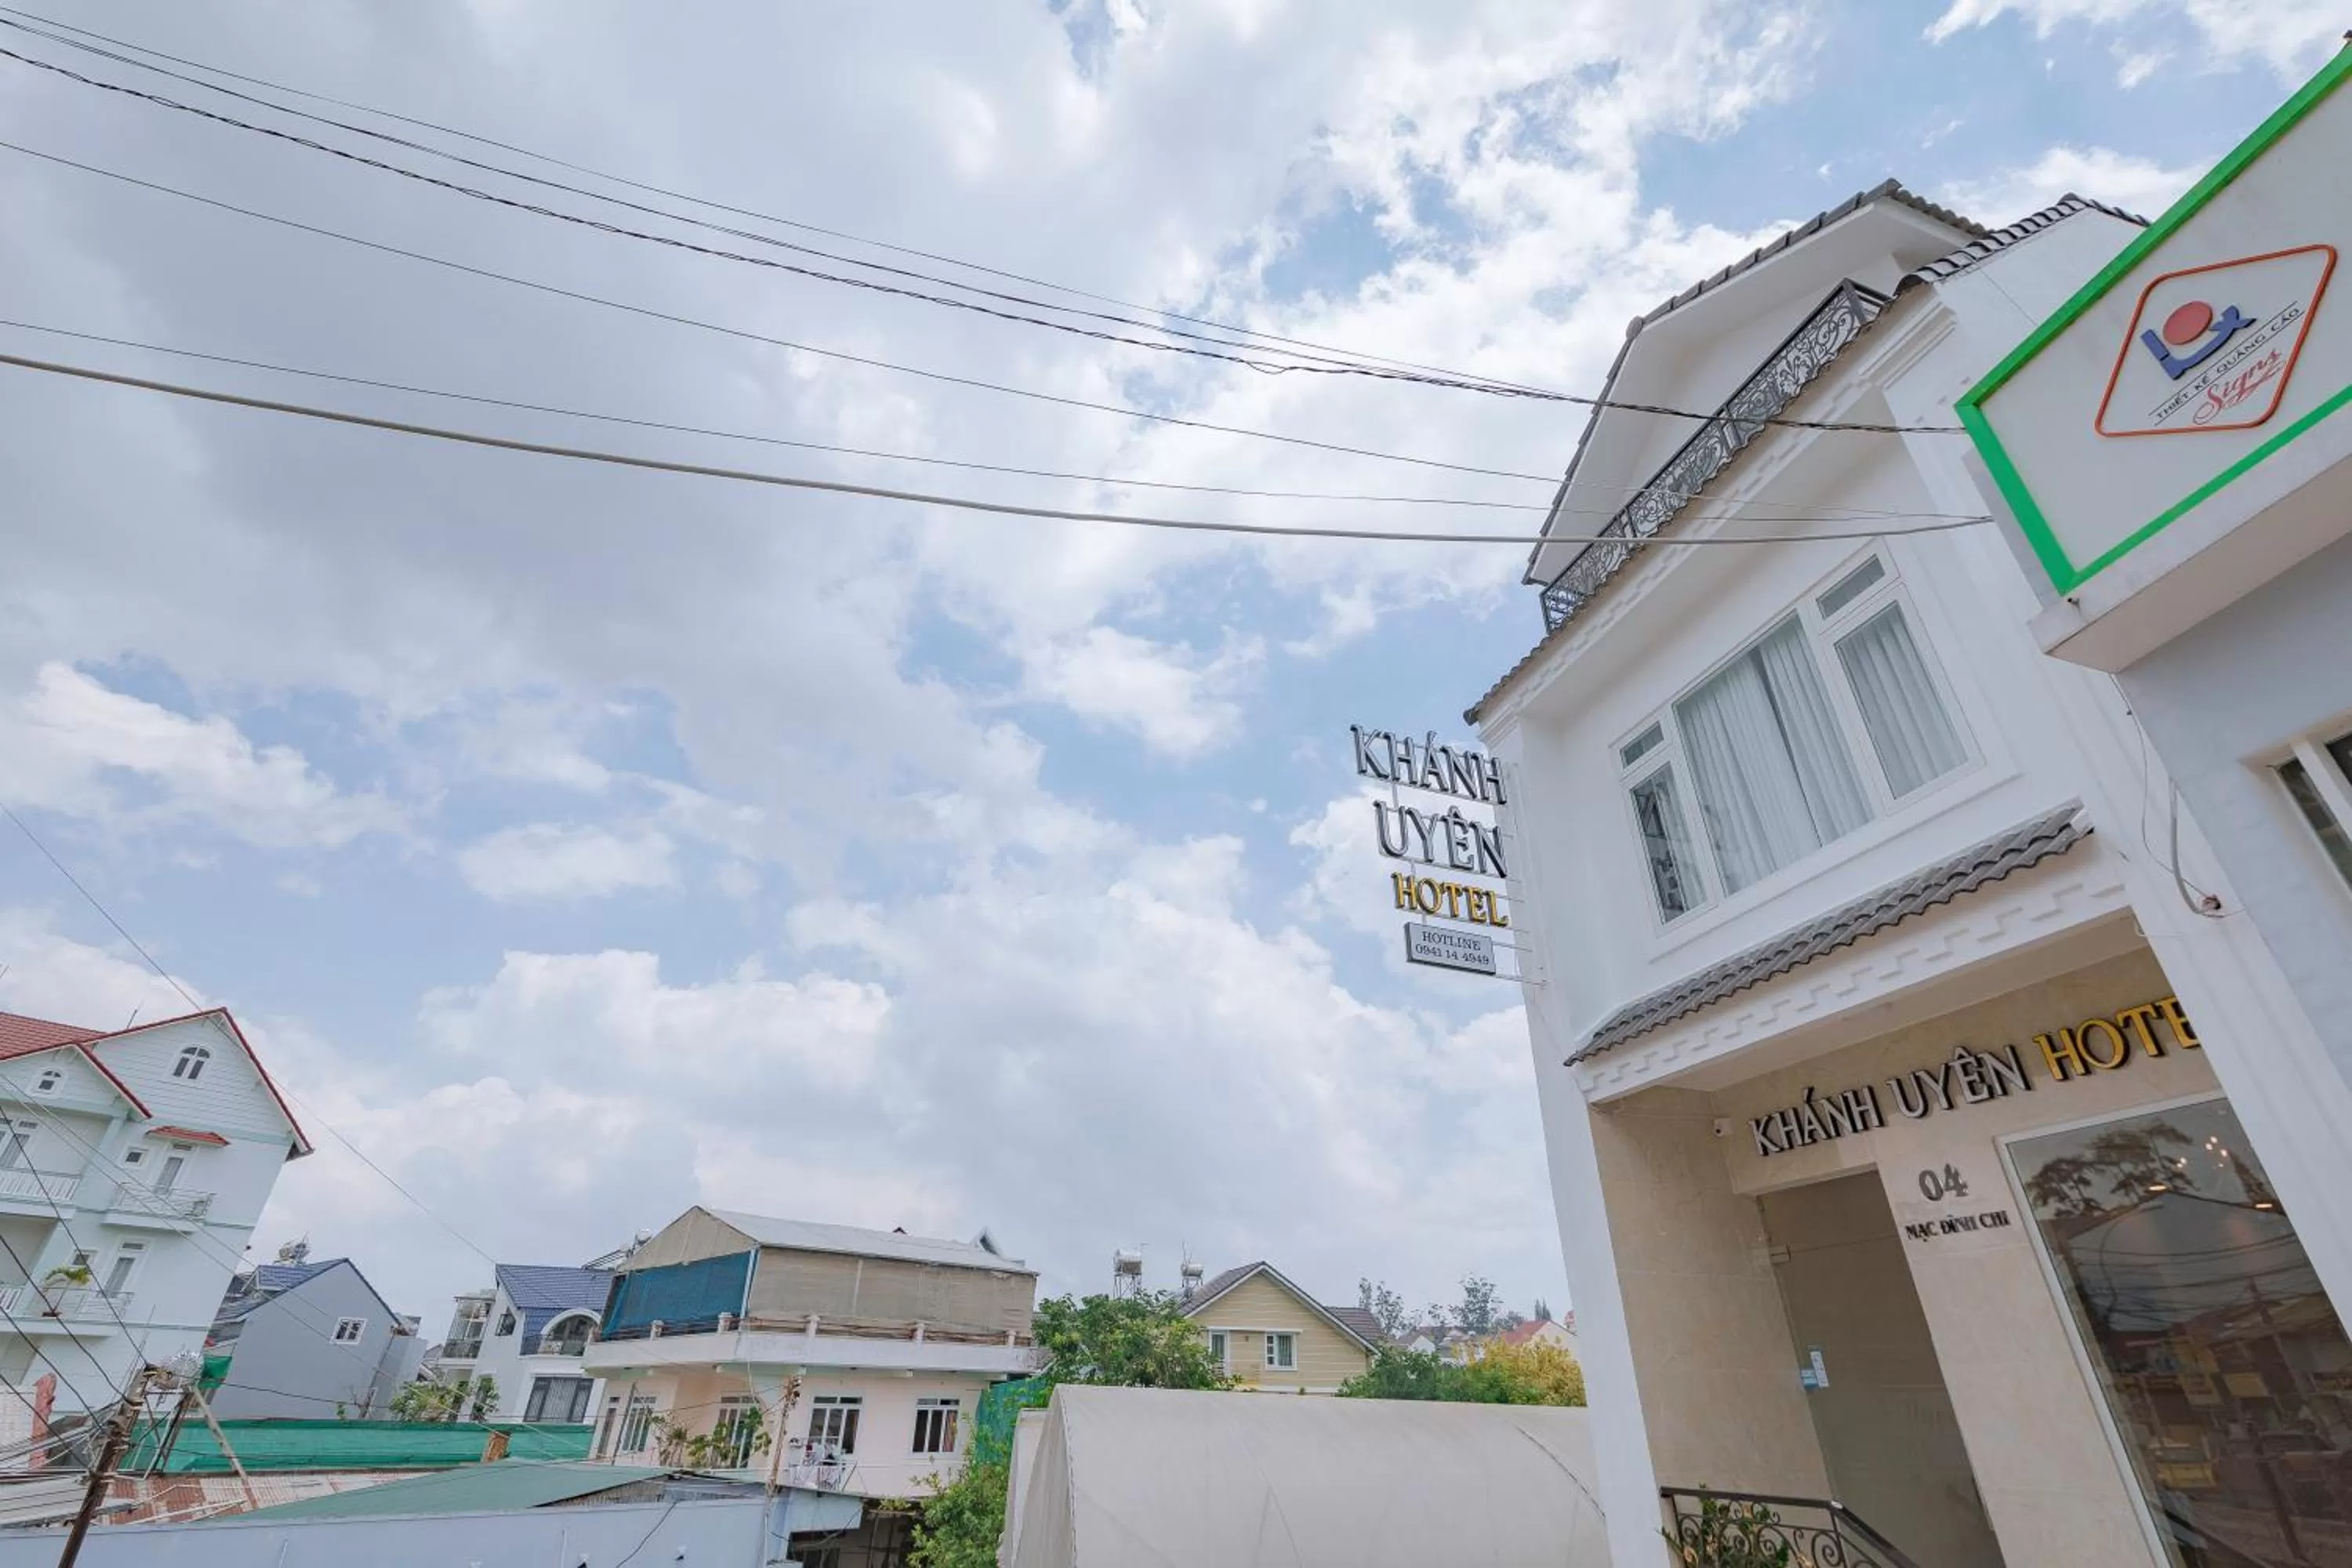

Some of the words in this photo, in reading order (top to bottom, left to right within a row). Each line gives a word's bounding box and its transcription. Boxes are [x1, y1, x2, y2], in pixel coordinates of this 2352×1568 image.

[1350, 724, 1507, 804] KHÁNH
[1373, 800, 1507, 878] UYÊN
[1391, 872, 1508, 927] HOTEL
[1421, 931, 1481, 951] HOTLINE
[1748, 1085, 1885, 1156] KHÁNH
[1885, 1045, 2031, 1119] UYÊN
[2032, 996, 2201, 1081] HOTE
[1918, 1163, 1969, 1201] 04
